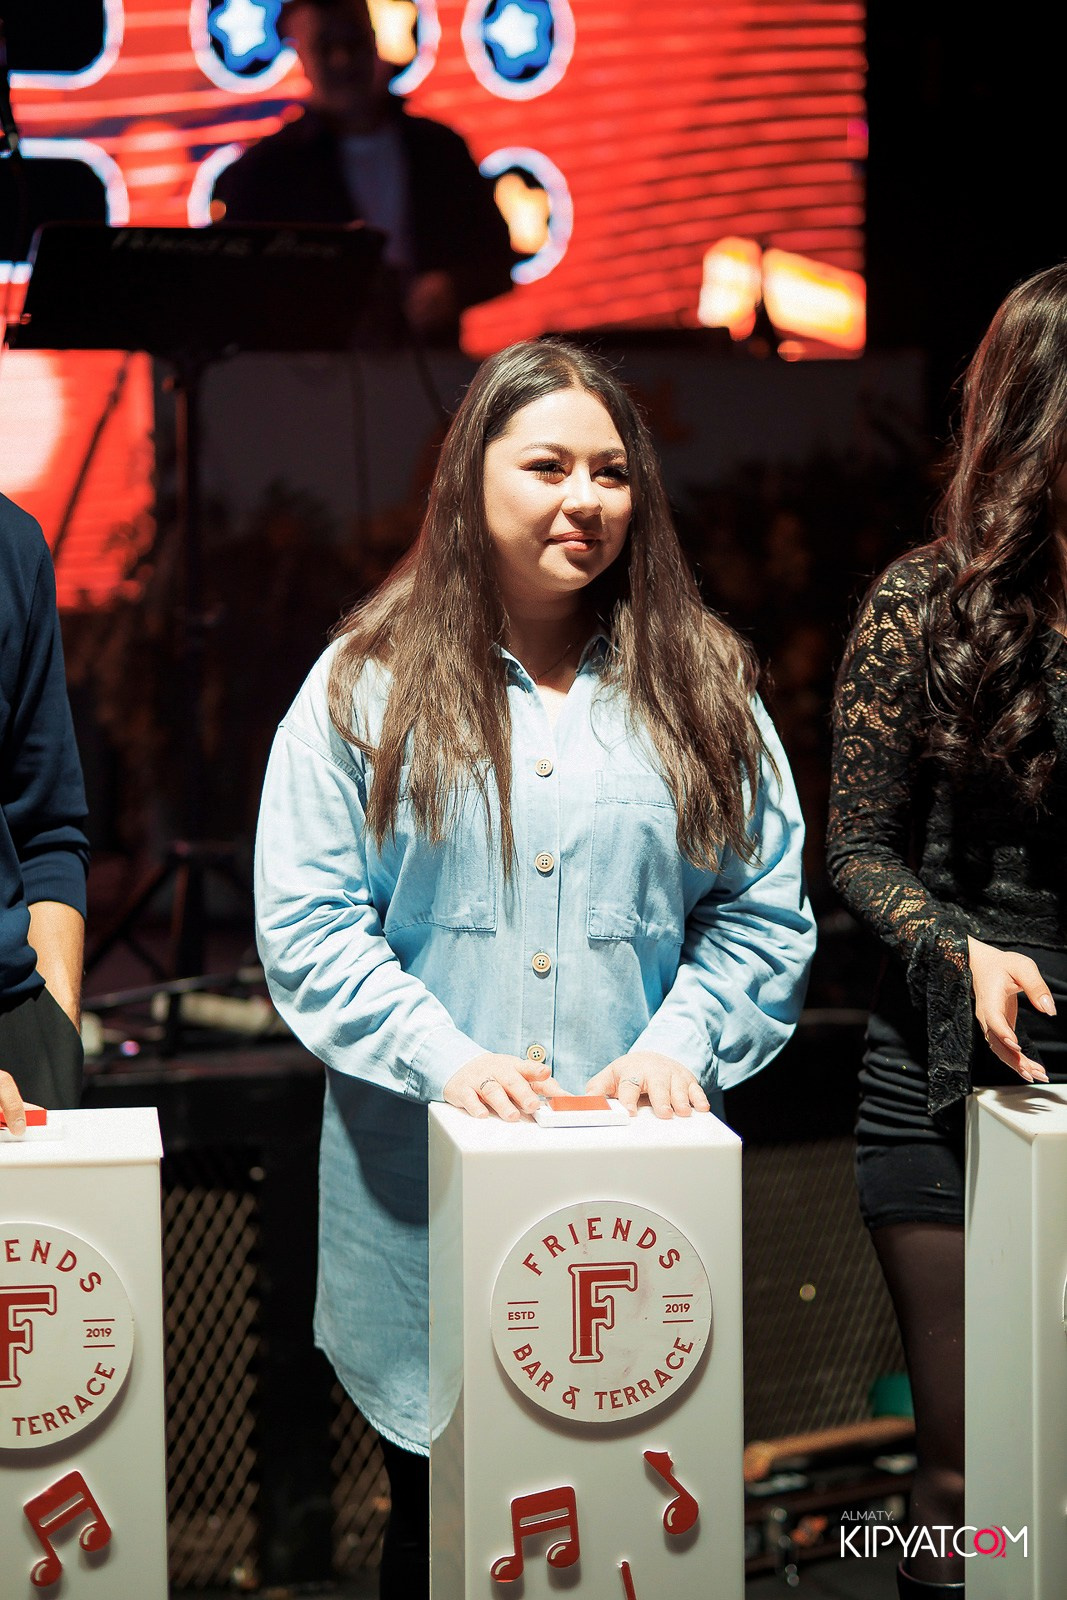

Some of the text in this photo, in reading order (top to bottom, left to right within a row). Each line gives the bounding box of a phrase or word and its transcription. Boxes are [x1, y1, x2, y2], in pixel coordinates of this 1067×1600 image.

[4, 1239, 101, 1292] ENDS
[522, 1217, 681, 1276] FRIENDS
[86, 1328, 112, 1338] 2019
[507, 1310, 536, 1321] ESTD
[567, 1261, 638, 1364] F
[665, 1303, 691, 1314] 2019
[12, 1362, 116, 1437] TERRACE
[512, 1337, 694, 1410] BAR & TERRACE
